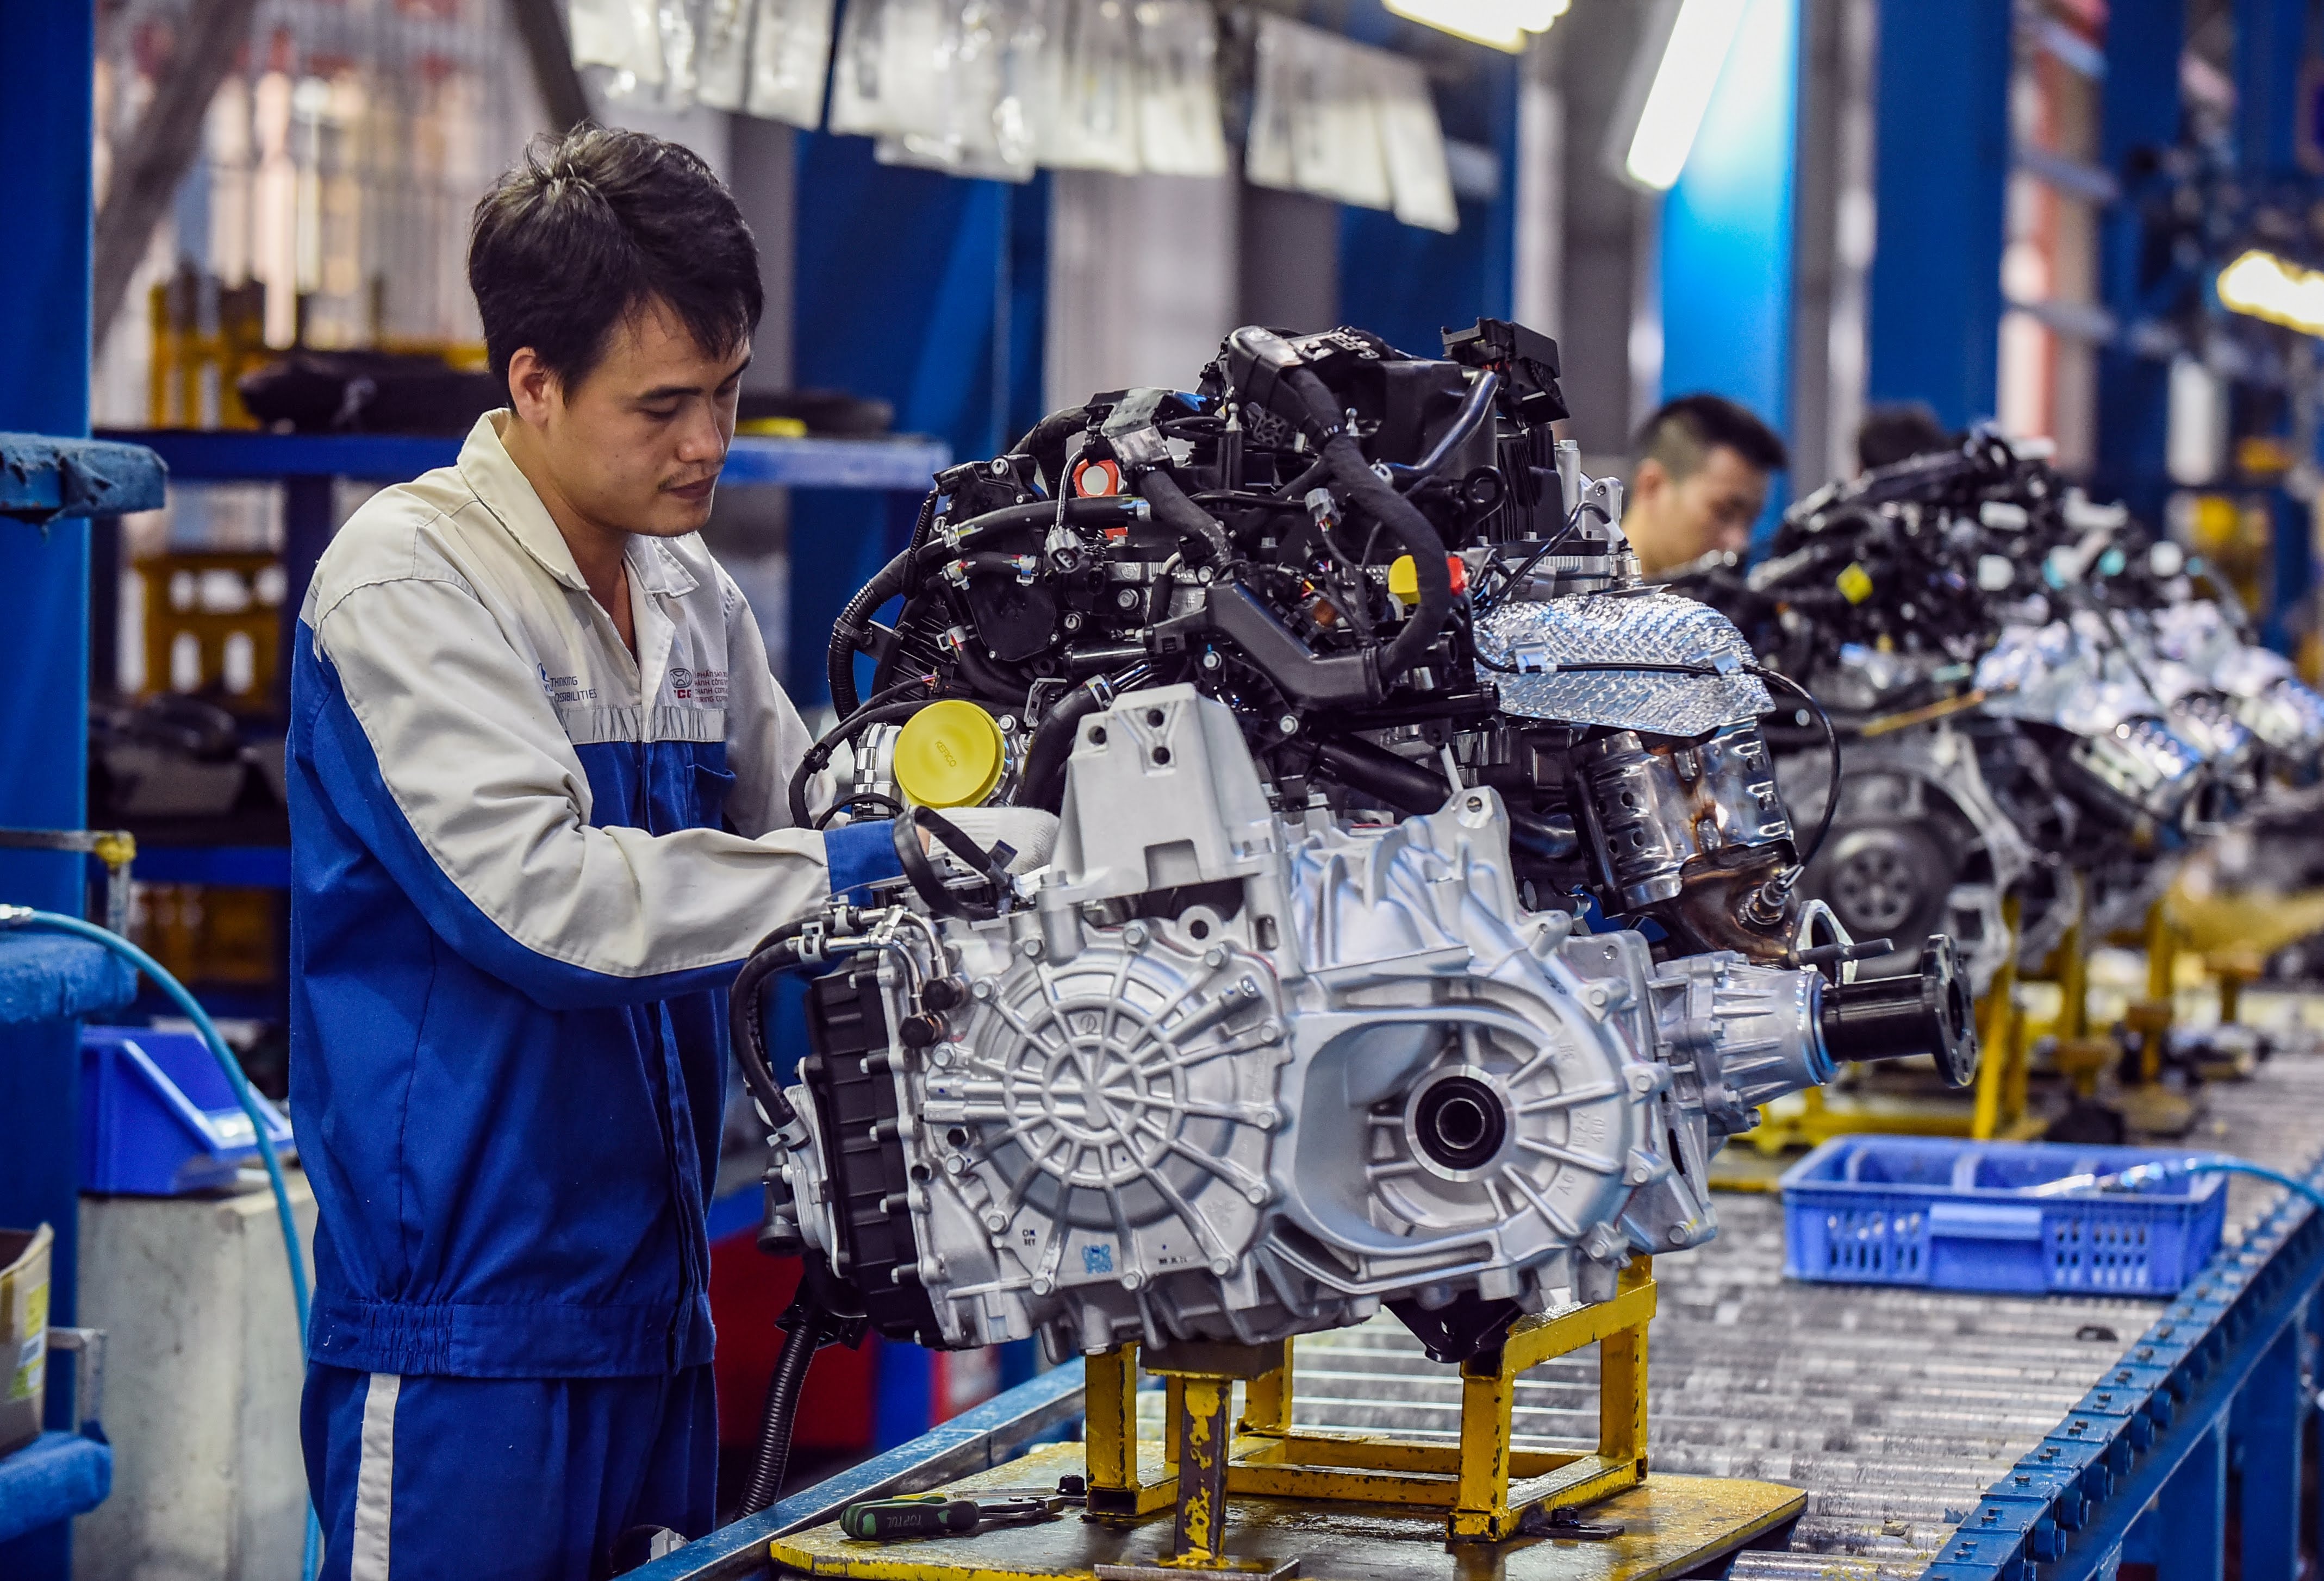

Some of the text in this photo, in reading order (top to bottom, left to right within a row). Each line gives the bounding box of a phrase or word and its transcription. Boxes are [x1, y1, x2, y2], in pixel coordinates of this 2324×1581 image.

[550, 676, 578, 687] THINKING
[554, 688, 597, 702] OSSIBILITIES
[935, 740, 956, 767] KEFICO
[887, 1515, 921, 1528] TOPTUL
